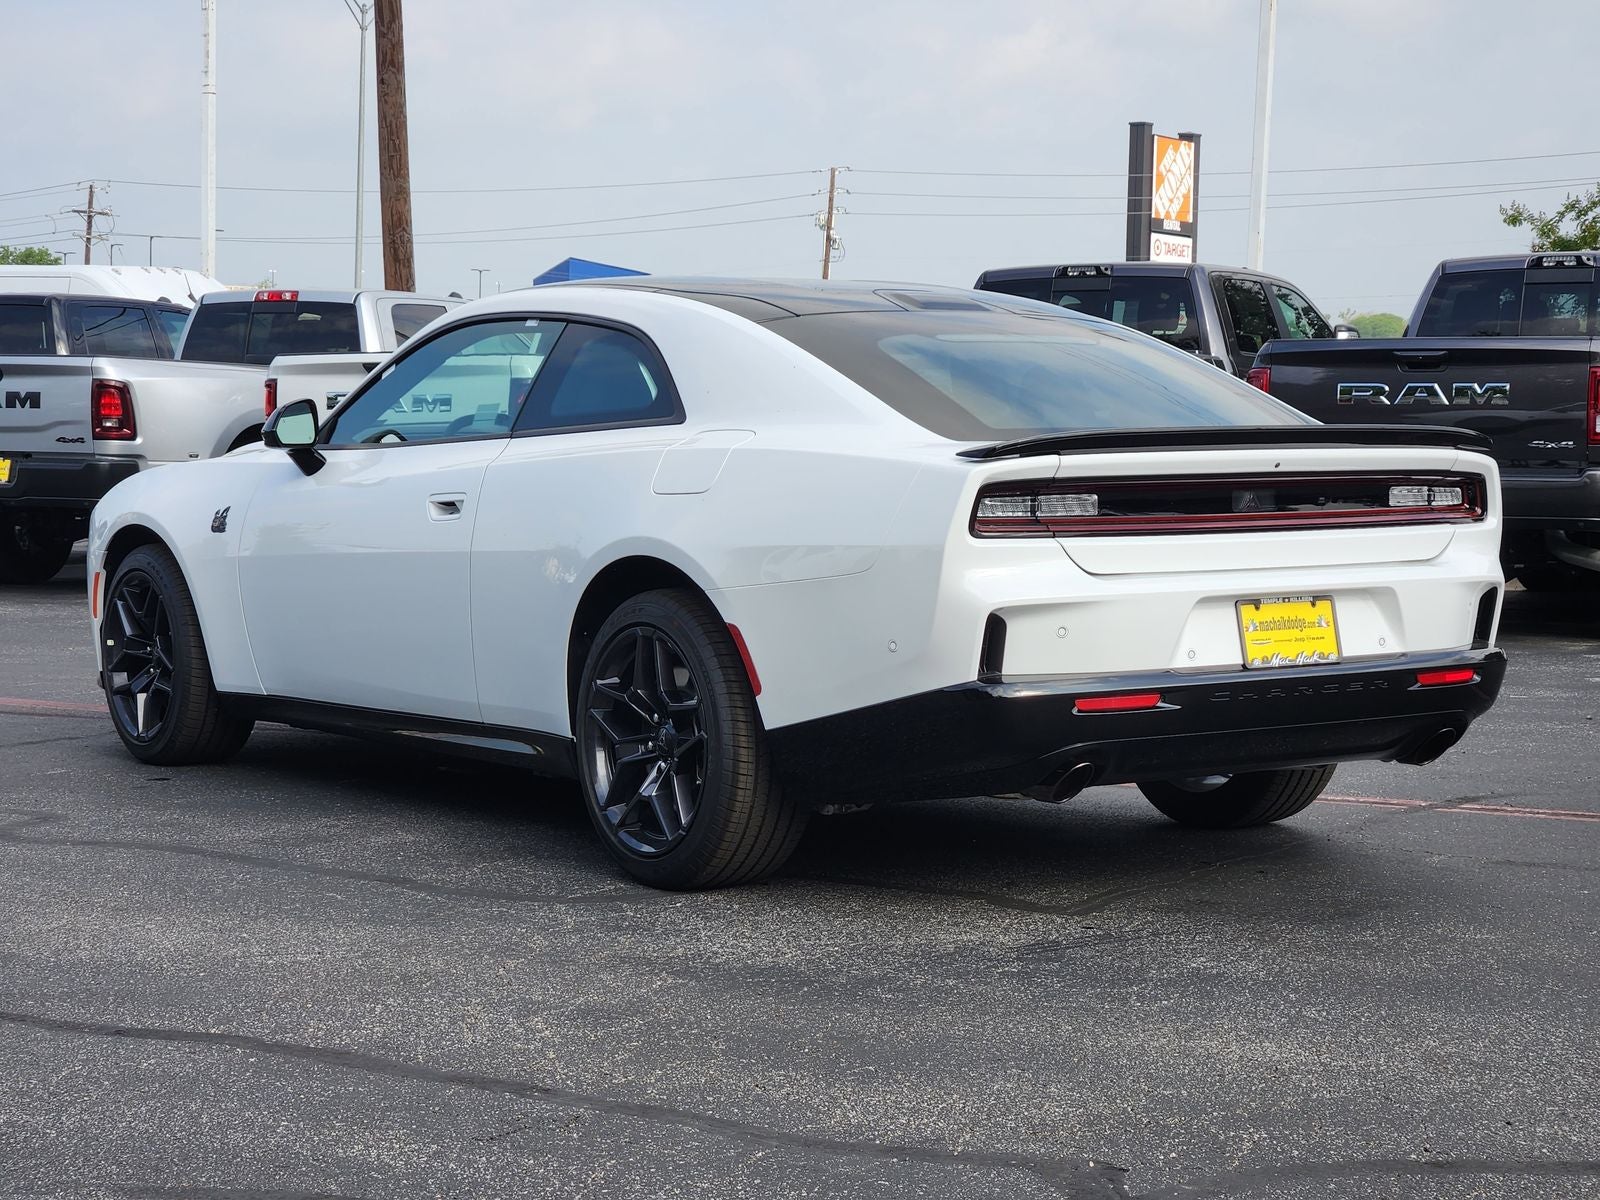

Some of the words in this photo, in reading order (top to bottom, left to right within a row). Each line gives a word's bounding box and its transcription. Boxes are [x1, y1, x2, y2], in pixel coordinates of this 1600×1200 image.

[1163, 241, 1190, 259] TARGET
[0, 391, 41, 409] M
[1337, 382, 1511, 406] RAM
[1270, 652, 1293, 667] Mac
